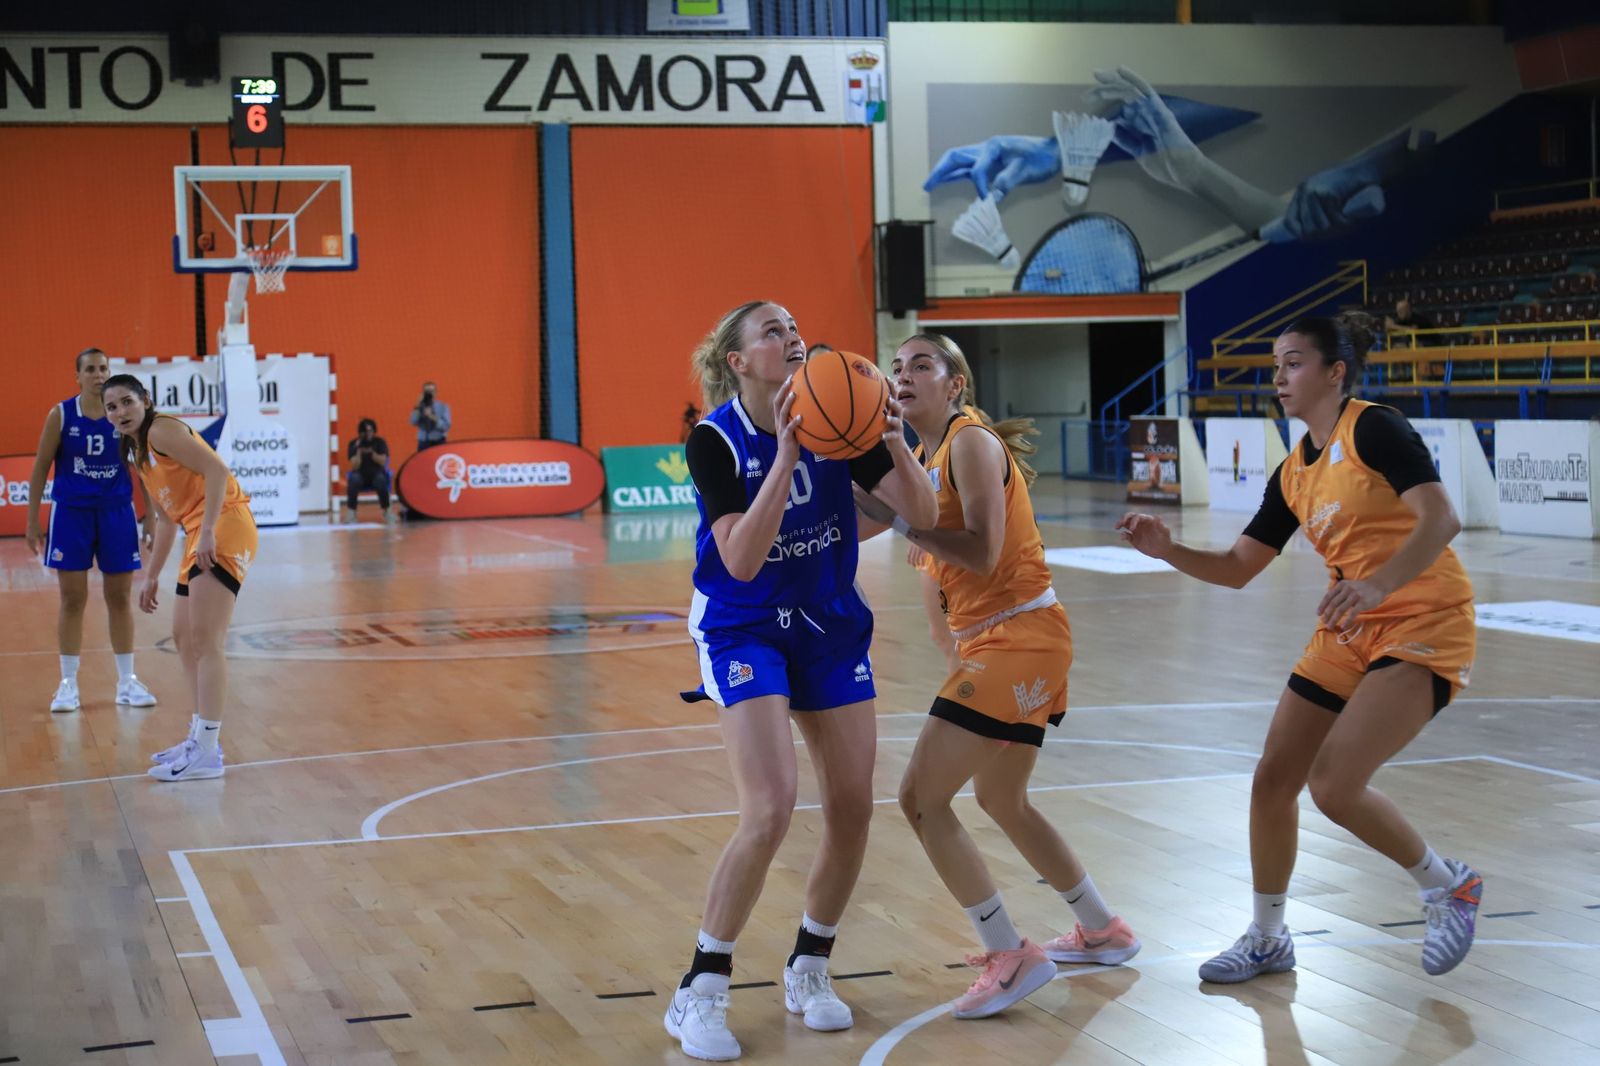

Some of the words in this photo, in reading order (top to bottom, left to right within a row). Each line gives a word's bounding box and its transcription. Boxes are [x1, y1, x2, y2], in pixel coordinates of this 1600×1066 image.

[0, 46, 164, 111] NTO
[272, 52, 376, 112] DE
[481, 53, 826, 112] ZAMORA
[247, 104, 268, 133] 6
[151, 374, 180, 407] La
[86, 434, 105, 456] 13
[472, 475, 524, 485] CASTILLA
[613, 486, 671, 507] CAJA
[1499, 482, 1546, 504] MARTA
